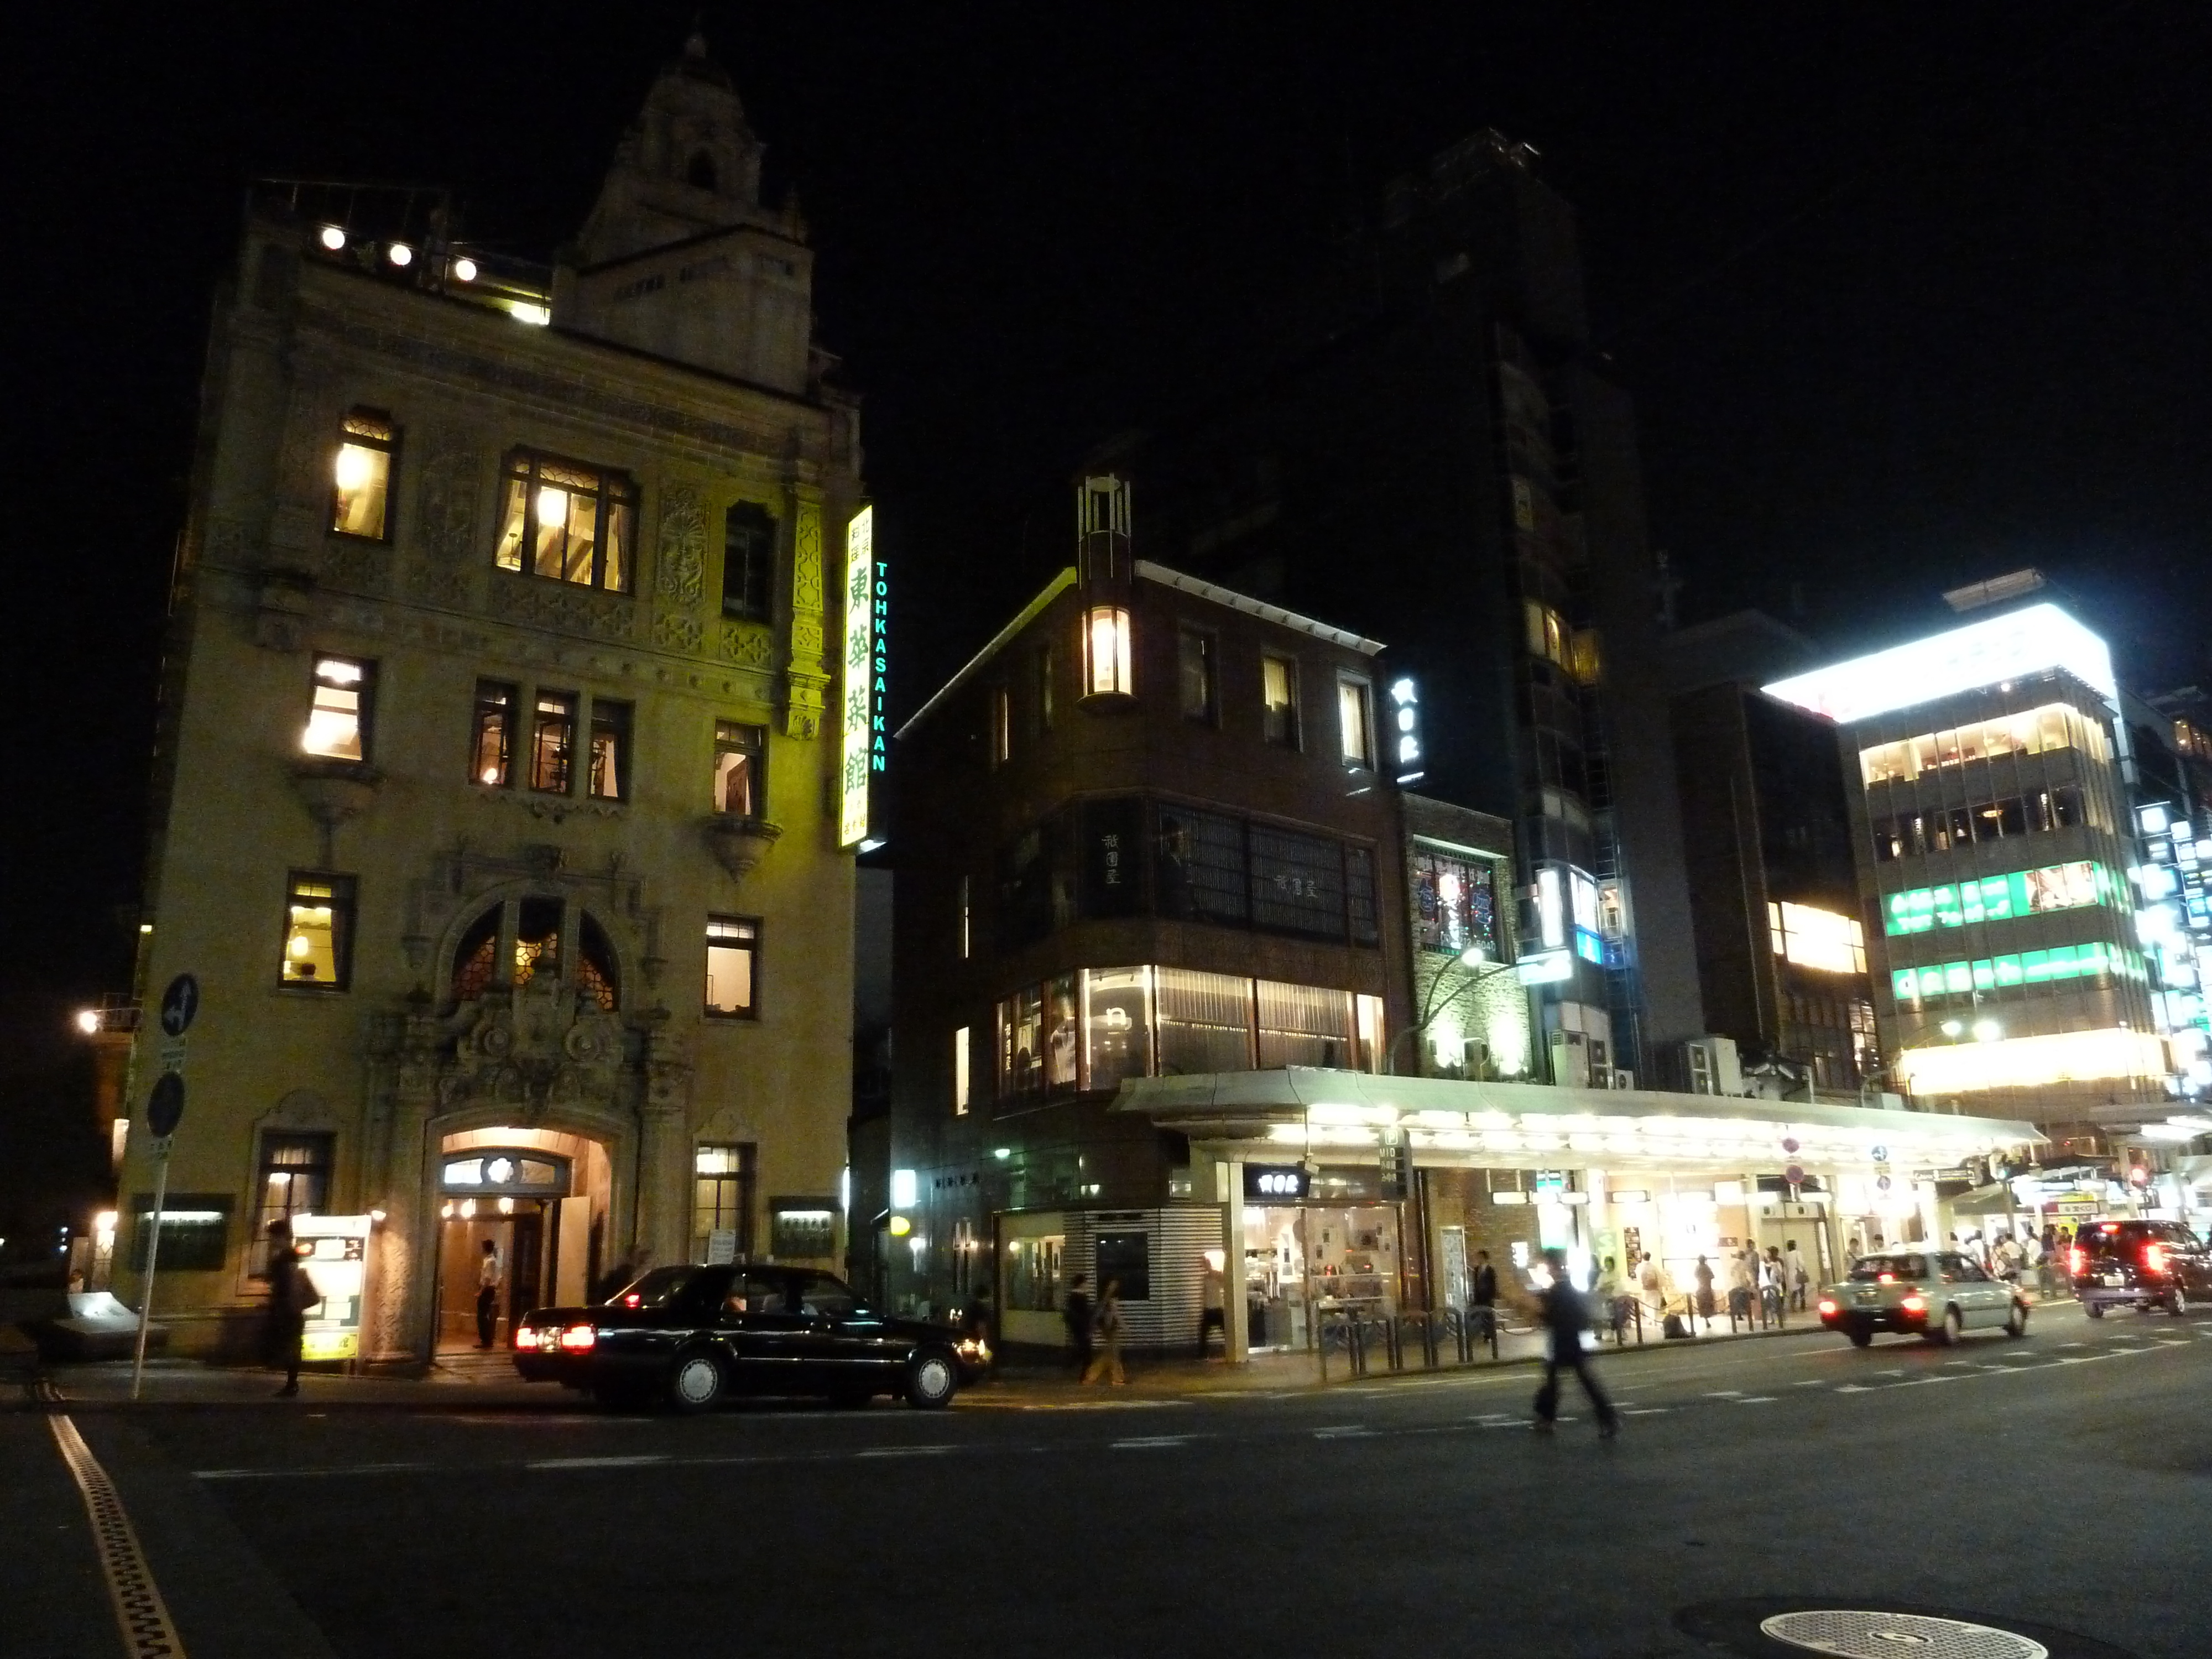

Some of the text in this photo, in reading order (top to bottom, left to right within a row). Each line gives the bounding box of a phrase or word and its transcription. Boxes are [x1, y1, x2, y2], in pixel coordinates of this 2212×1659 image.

[851, 524, 859, 564] 料理
[861, 518, 869, 556] 北京
[844, 566, 869, 795] 東華菜館
[873, 561, 888, 771] TOHKASAIKAN
[1380, 1147, 1395, 1157] MID
